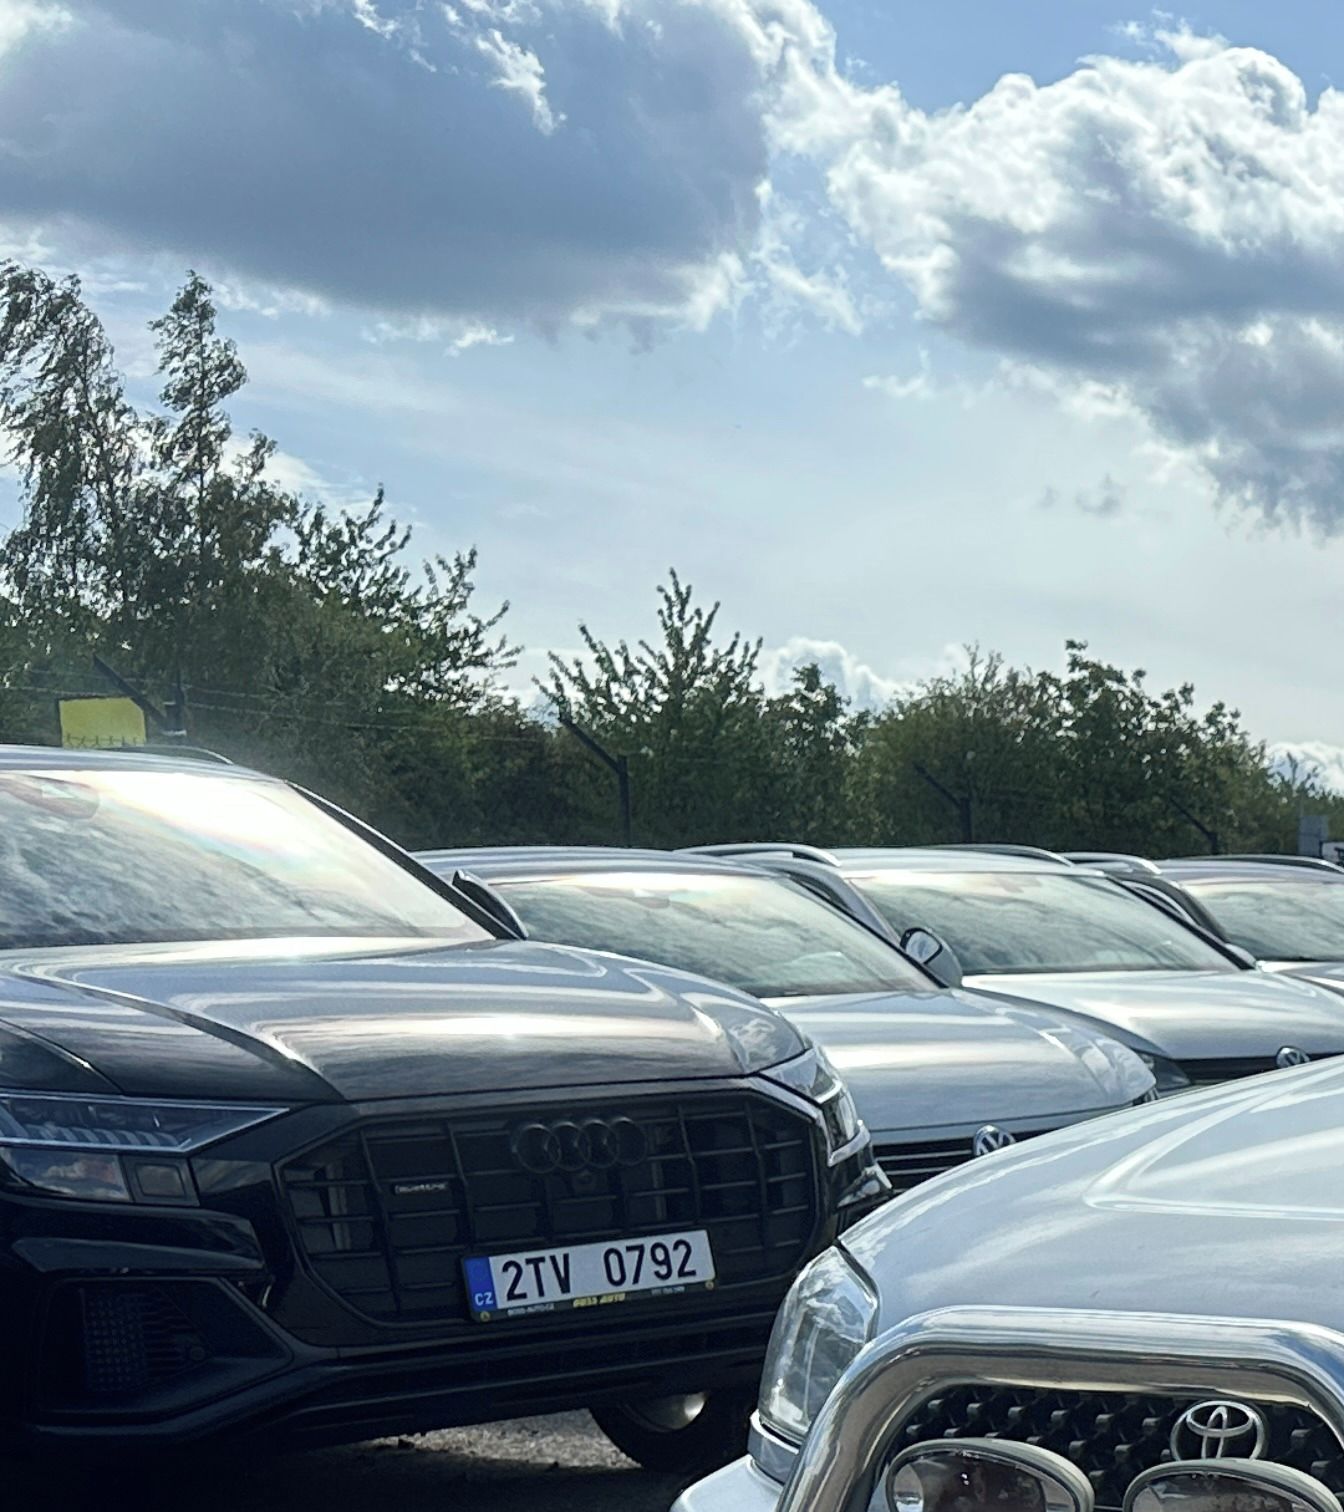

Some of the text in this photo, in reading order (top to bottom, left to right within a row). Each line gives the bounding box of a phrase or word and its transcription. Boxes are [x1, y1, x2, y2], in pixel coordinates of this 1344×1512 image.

[501, 1238, 698, 1303] 2TV 0792
[473, 1291, 495, 1307] CZ
